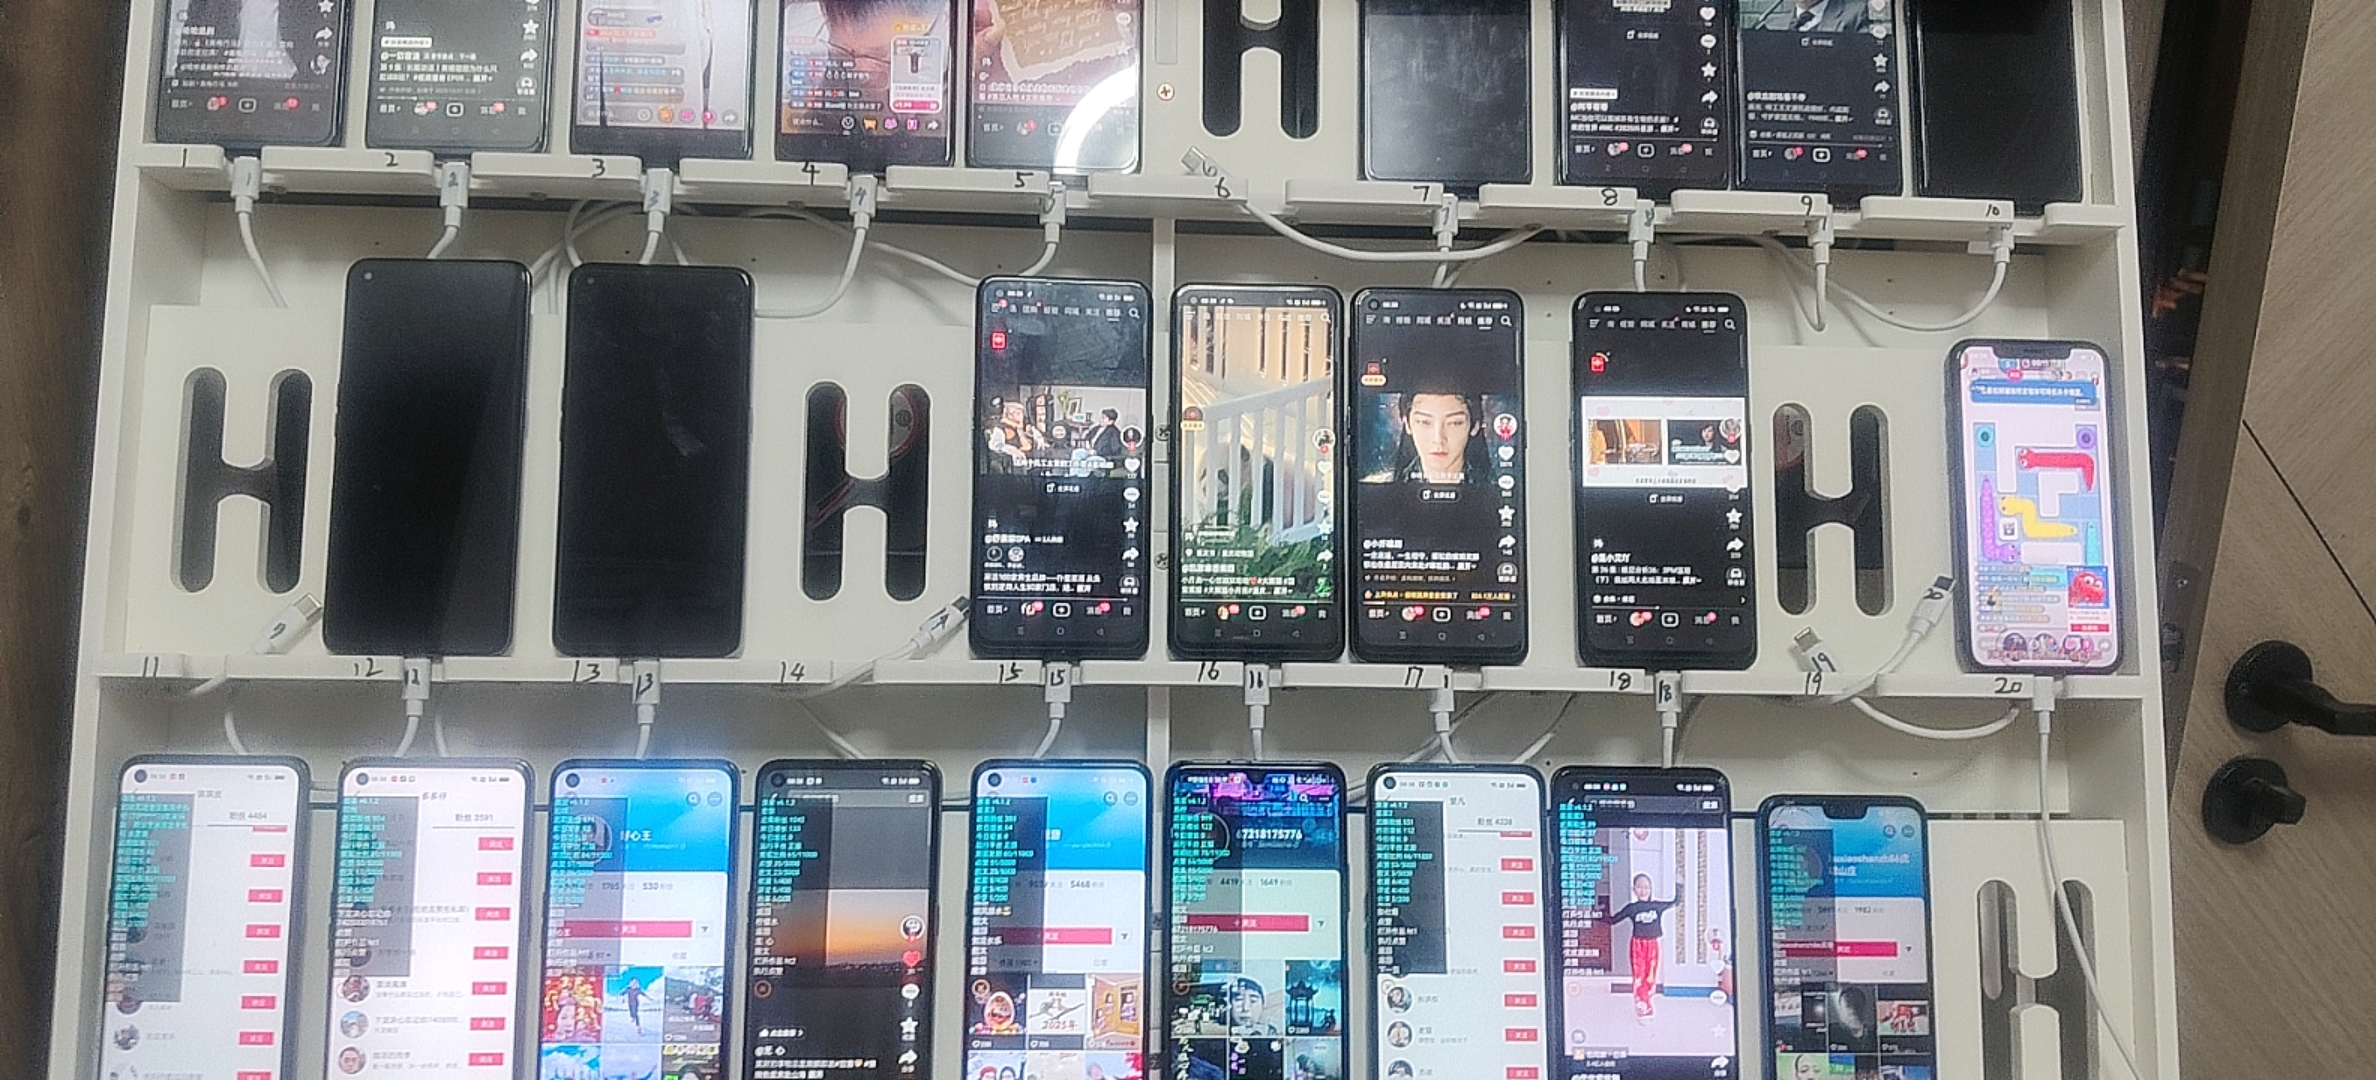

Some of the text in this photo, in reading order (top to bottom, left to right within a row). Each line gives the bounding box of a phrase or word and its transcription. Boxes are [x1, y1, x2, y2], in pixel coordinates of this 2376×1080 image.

[182, 148, 188, 168] 1
[385, 152, 399, 167] 2
[591, 158, 606, 178] 3
[802, 161, 820, 186] 4
[1014, 172, 1034, 188] 5
[853, 186, 868, 206] 4
[1214, 176, 1231, 198] 6
[1413, 185, 1430, 202] 7
[1601, 188, 1618, 206] 8
[1800, 195, 1813, 216] 9
[1985, 204, 2001, 217] 10
[141, 656, 160, 679] 11
[354, 657, 383, 677] 12
[572, 660, 601, 682] 13
[780, 661, 805, 682] 14
[999, 663, 1023, 683] 15
[1198, 661, 1220, 682] 16
[1811, 653, 1836, 673] 19
[635, 673, 655, 698] 13
[1049, 669, 1065, 687] 15
[1404, 666, 1424, 689] 17
[1609, 670, 1632, 691] 18
[1805, 672, 1823, 696] 19
[1994, 677, 2023, 694] 20
[1658, 680, 1673, 702] 18
